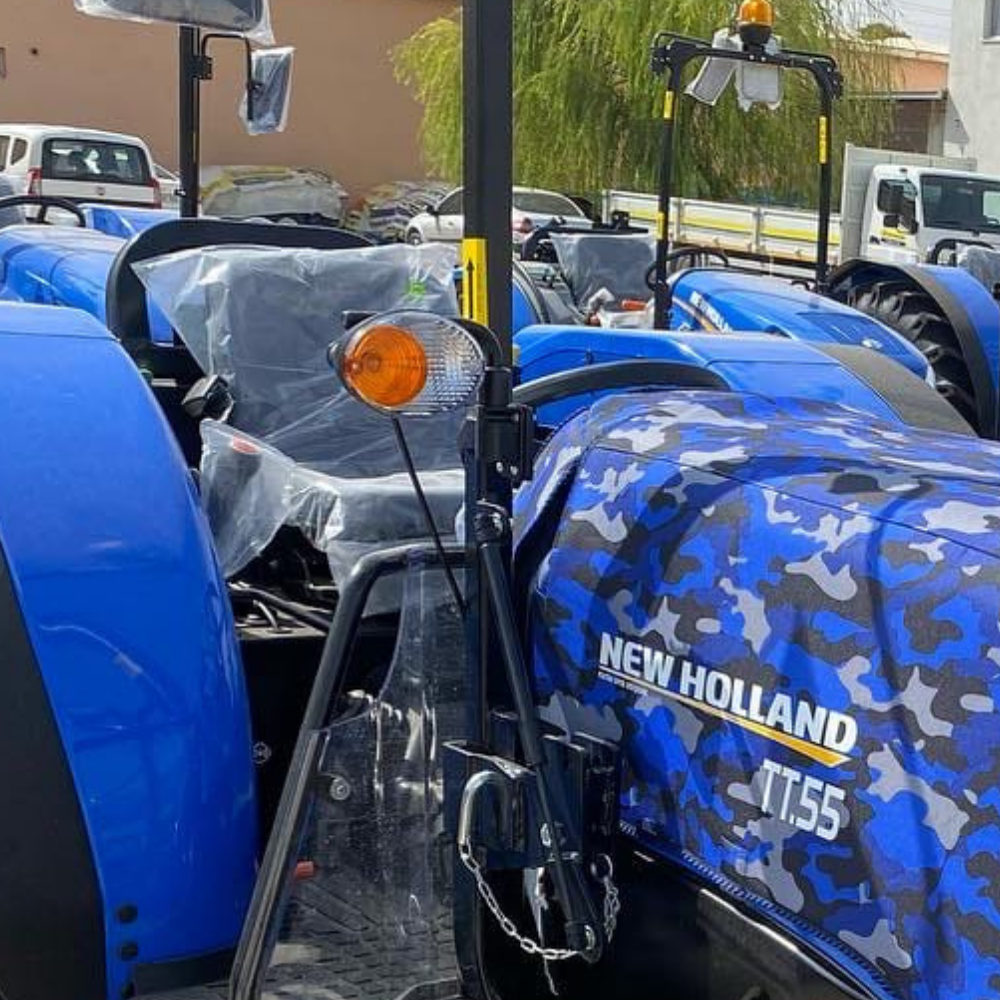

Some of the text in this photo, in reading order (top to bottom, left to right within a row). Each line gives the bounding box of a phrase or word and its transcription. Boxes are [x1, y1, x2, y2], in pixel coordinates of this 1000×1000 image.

[599, 632, 858, 754] NEW HOLLAND
[760, 758, 847, 842] TT.55
